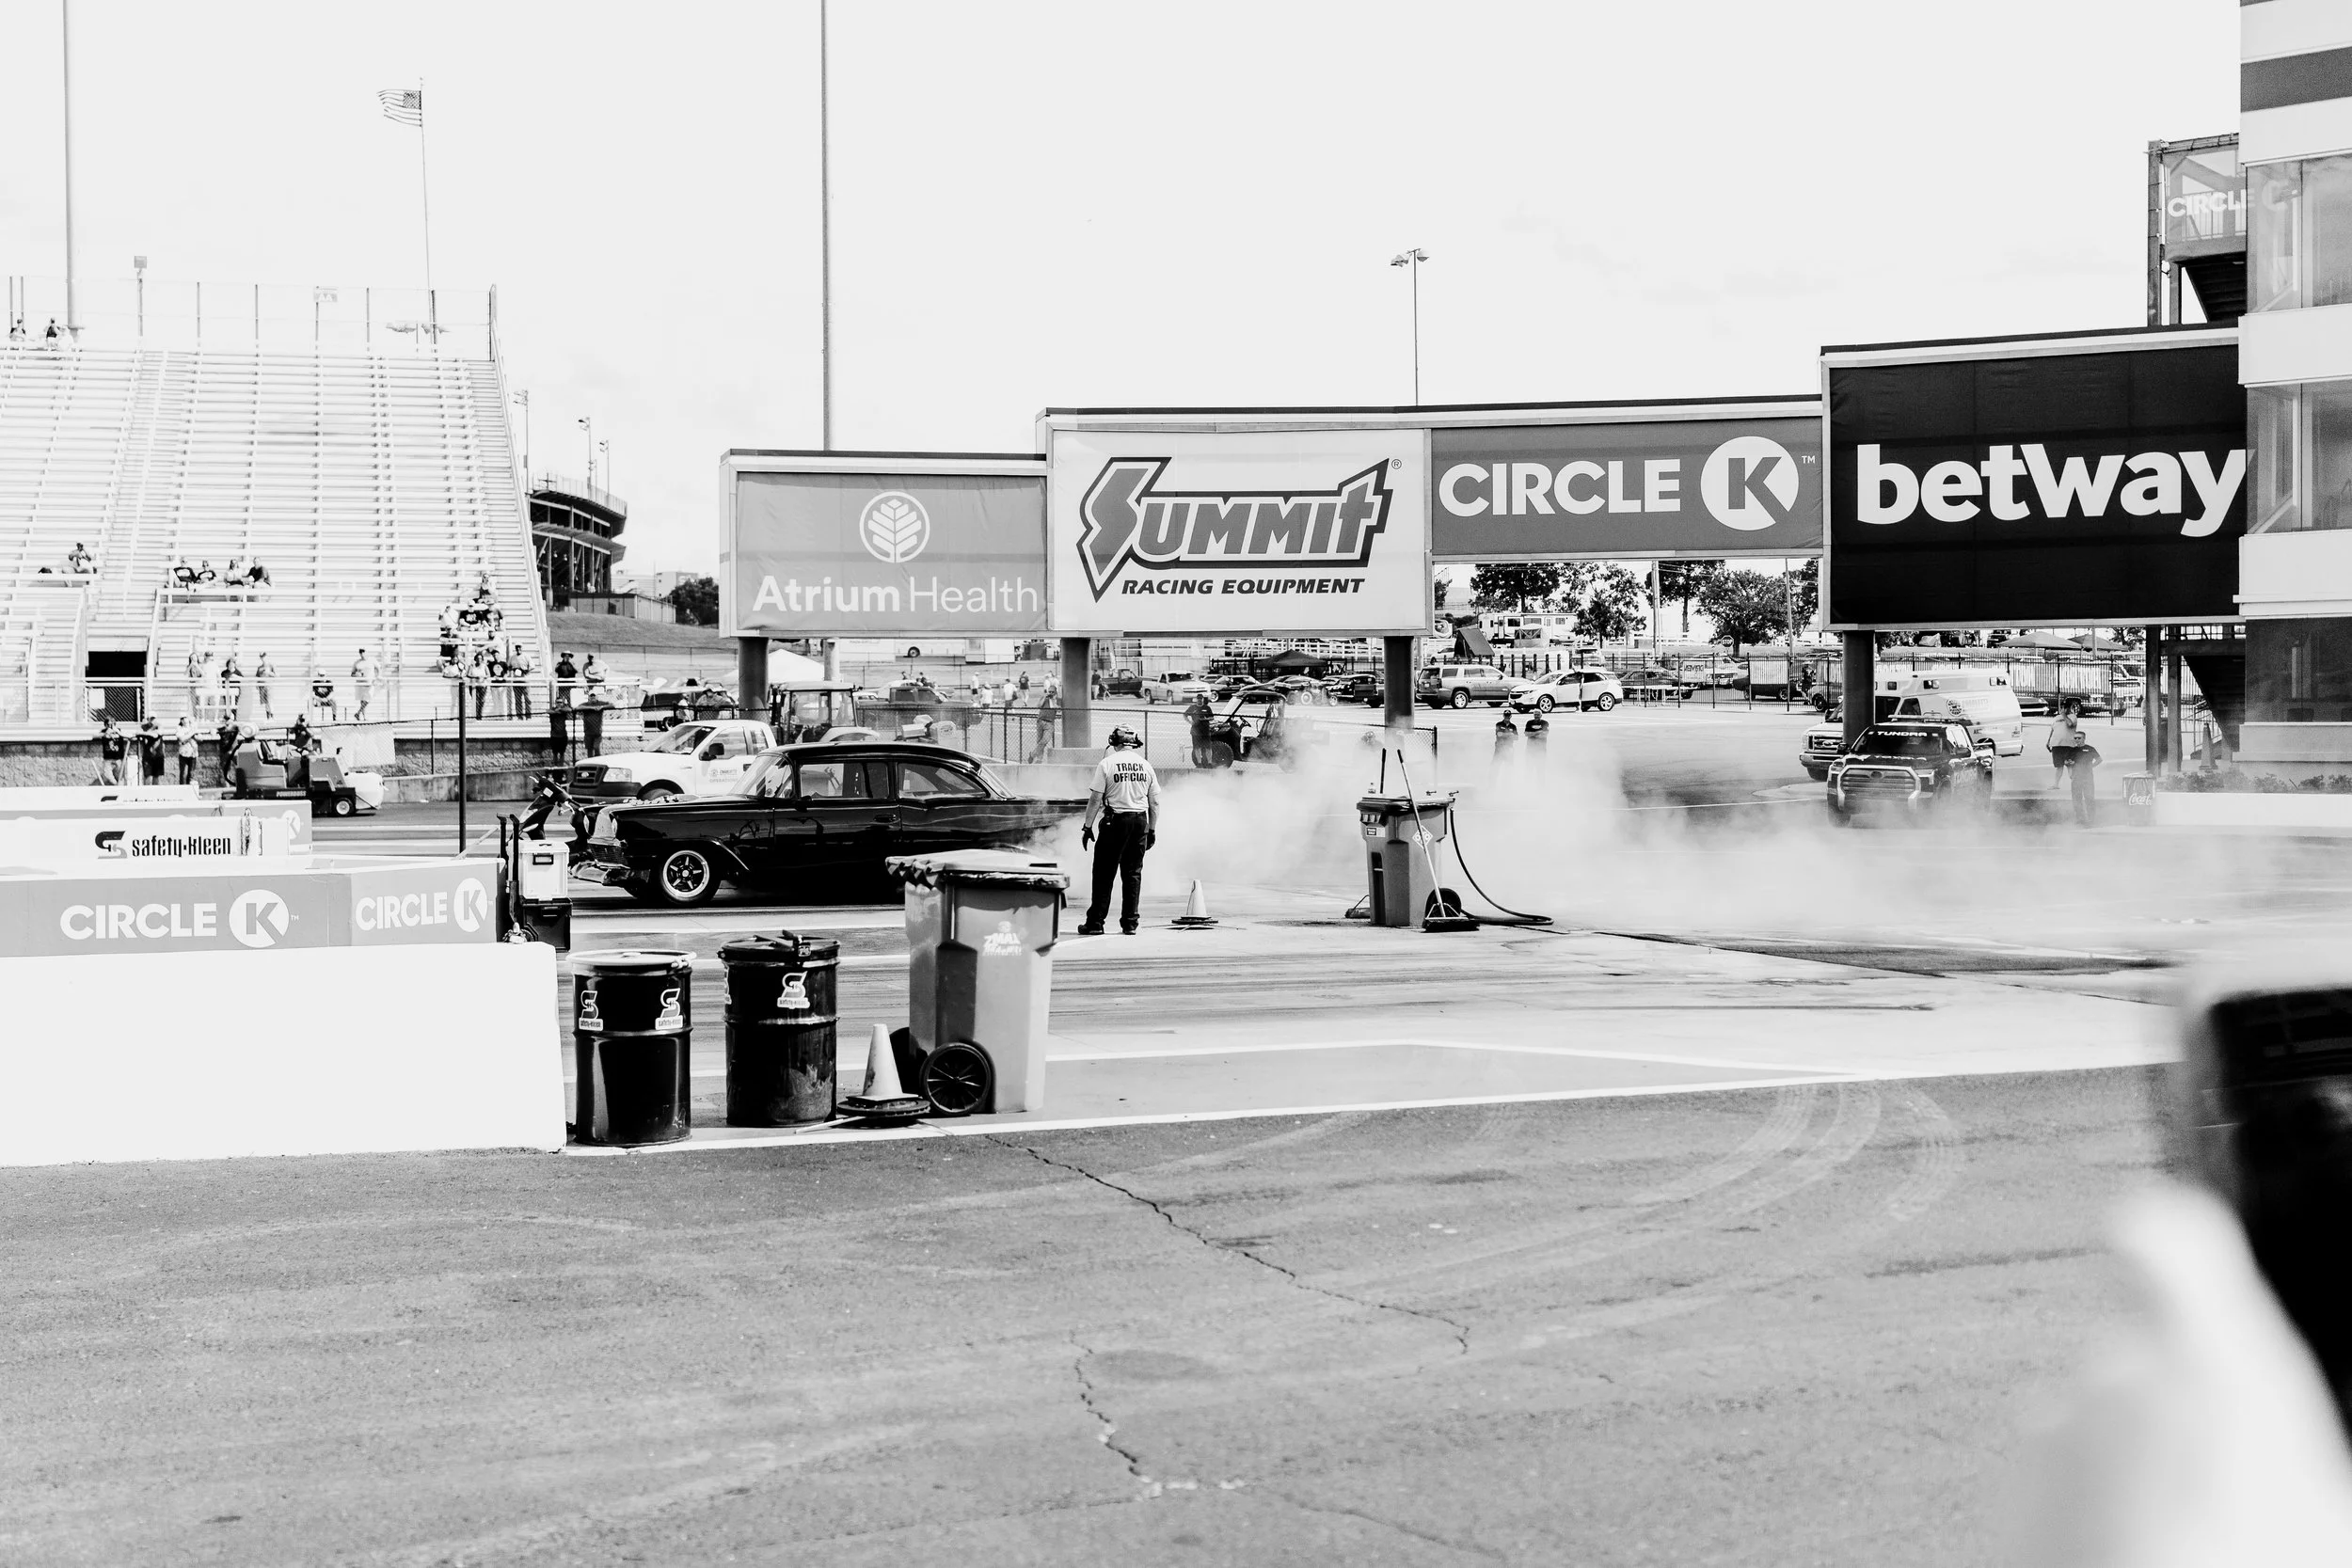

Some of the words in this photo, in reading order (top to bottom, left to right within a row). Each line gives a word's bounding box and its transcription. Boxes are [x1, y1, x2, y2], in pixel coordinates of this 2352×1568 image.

[1438, 459, 1681, 516] CIRCLE
[1857, 443, 2255, 537] betway
[753, 576, 900, 612] Atrium
[910, 576, 1038, 612] Health
[1121, 579, 1214, 594] RACING
[1221, 578, 1365, 594] EQUIPMENT
[1113, 772, 1147, 783] OFFICIAL
[1116, 763, 1144, 772] TRACK
[60, 902, 217, 940] CIRCLE
[355, 891, 448, 931] CIRCLE
